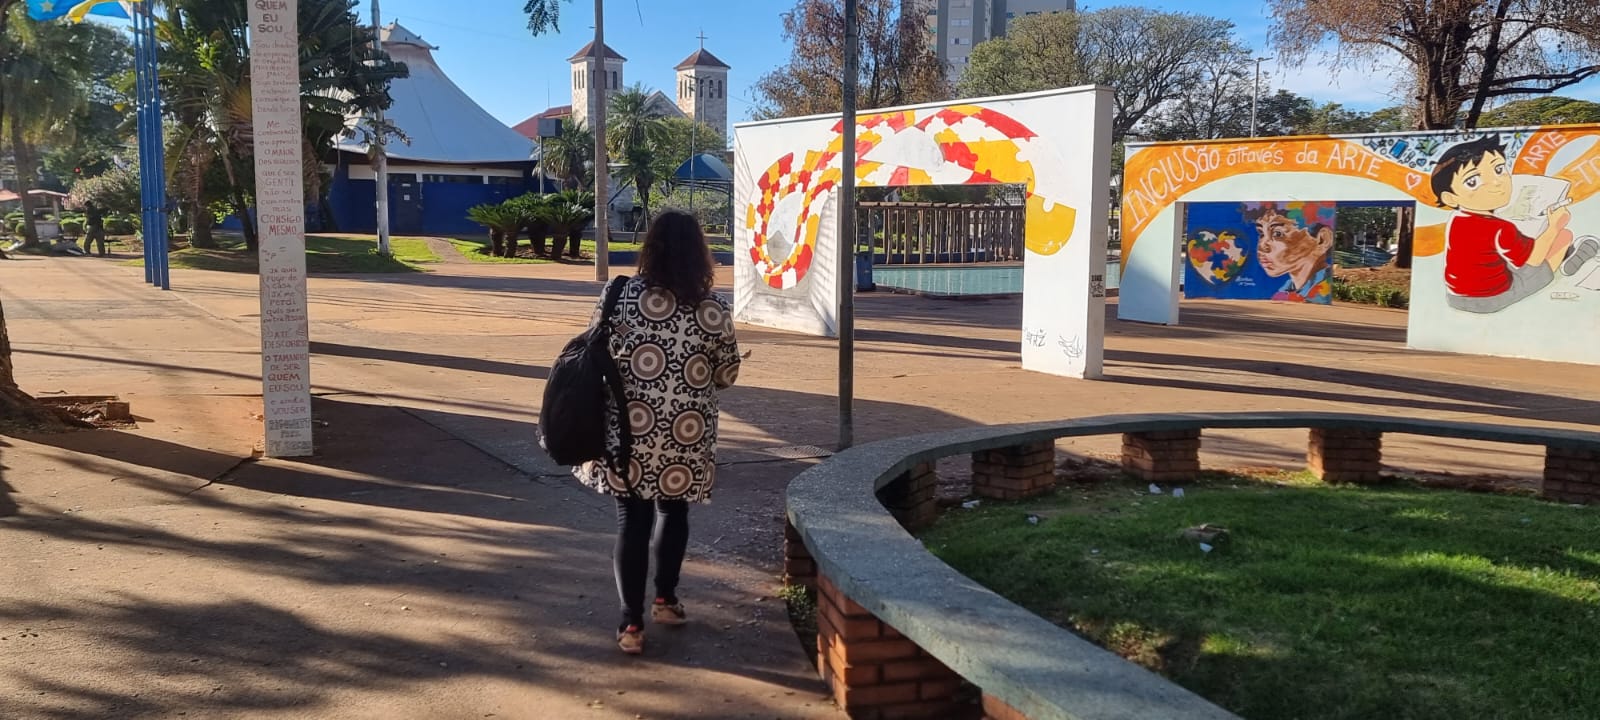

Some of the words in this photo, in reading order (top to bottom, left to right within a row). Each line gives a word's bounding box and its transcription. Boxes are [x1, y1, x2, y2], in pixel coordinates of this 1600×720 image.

[262, 14, 278, 22] EU
[257, 24, 283, 33] SOU
[1521, 129, 1567, 169] ARTE
[1226, 141, 1284, 166] através
[1295, 142, 1319, 165] da
[1325, 142, 1384, 177] ARTE
[268, 225, 297, 237] MESMO
[267, 373, 301, 381] QUEM
[268, 384, 281, 392] EU
[282, 383, 305, 392] SOU
